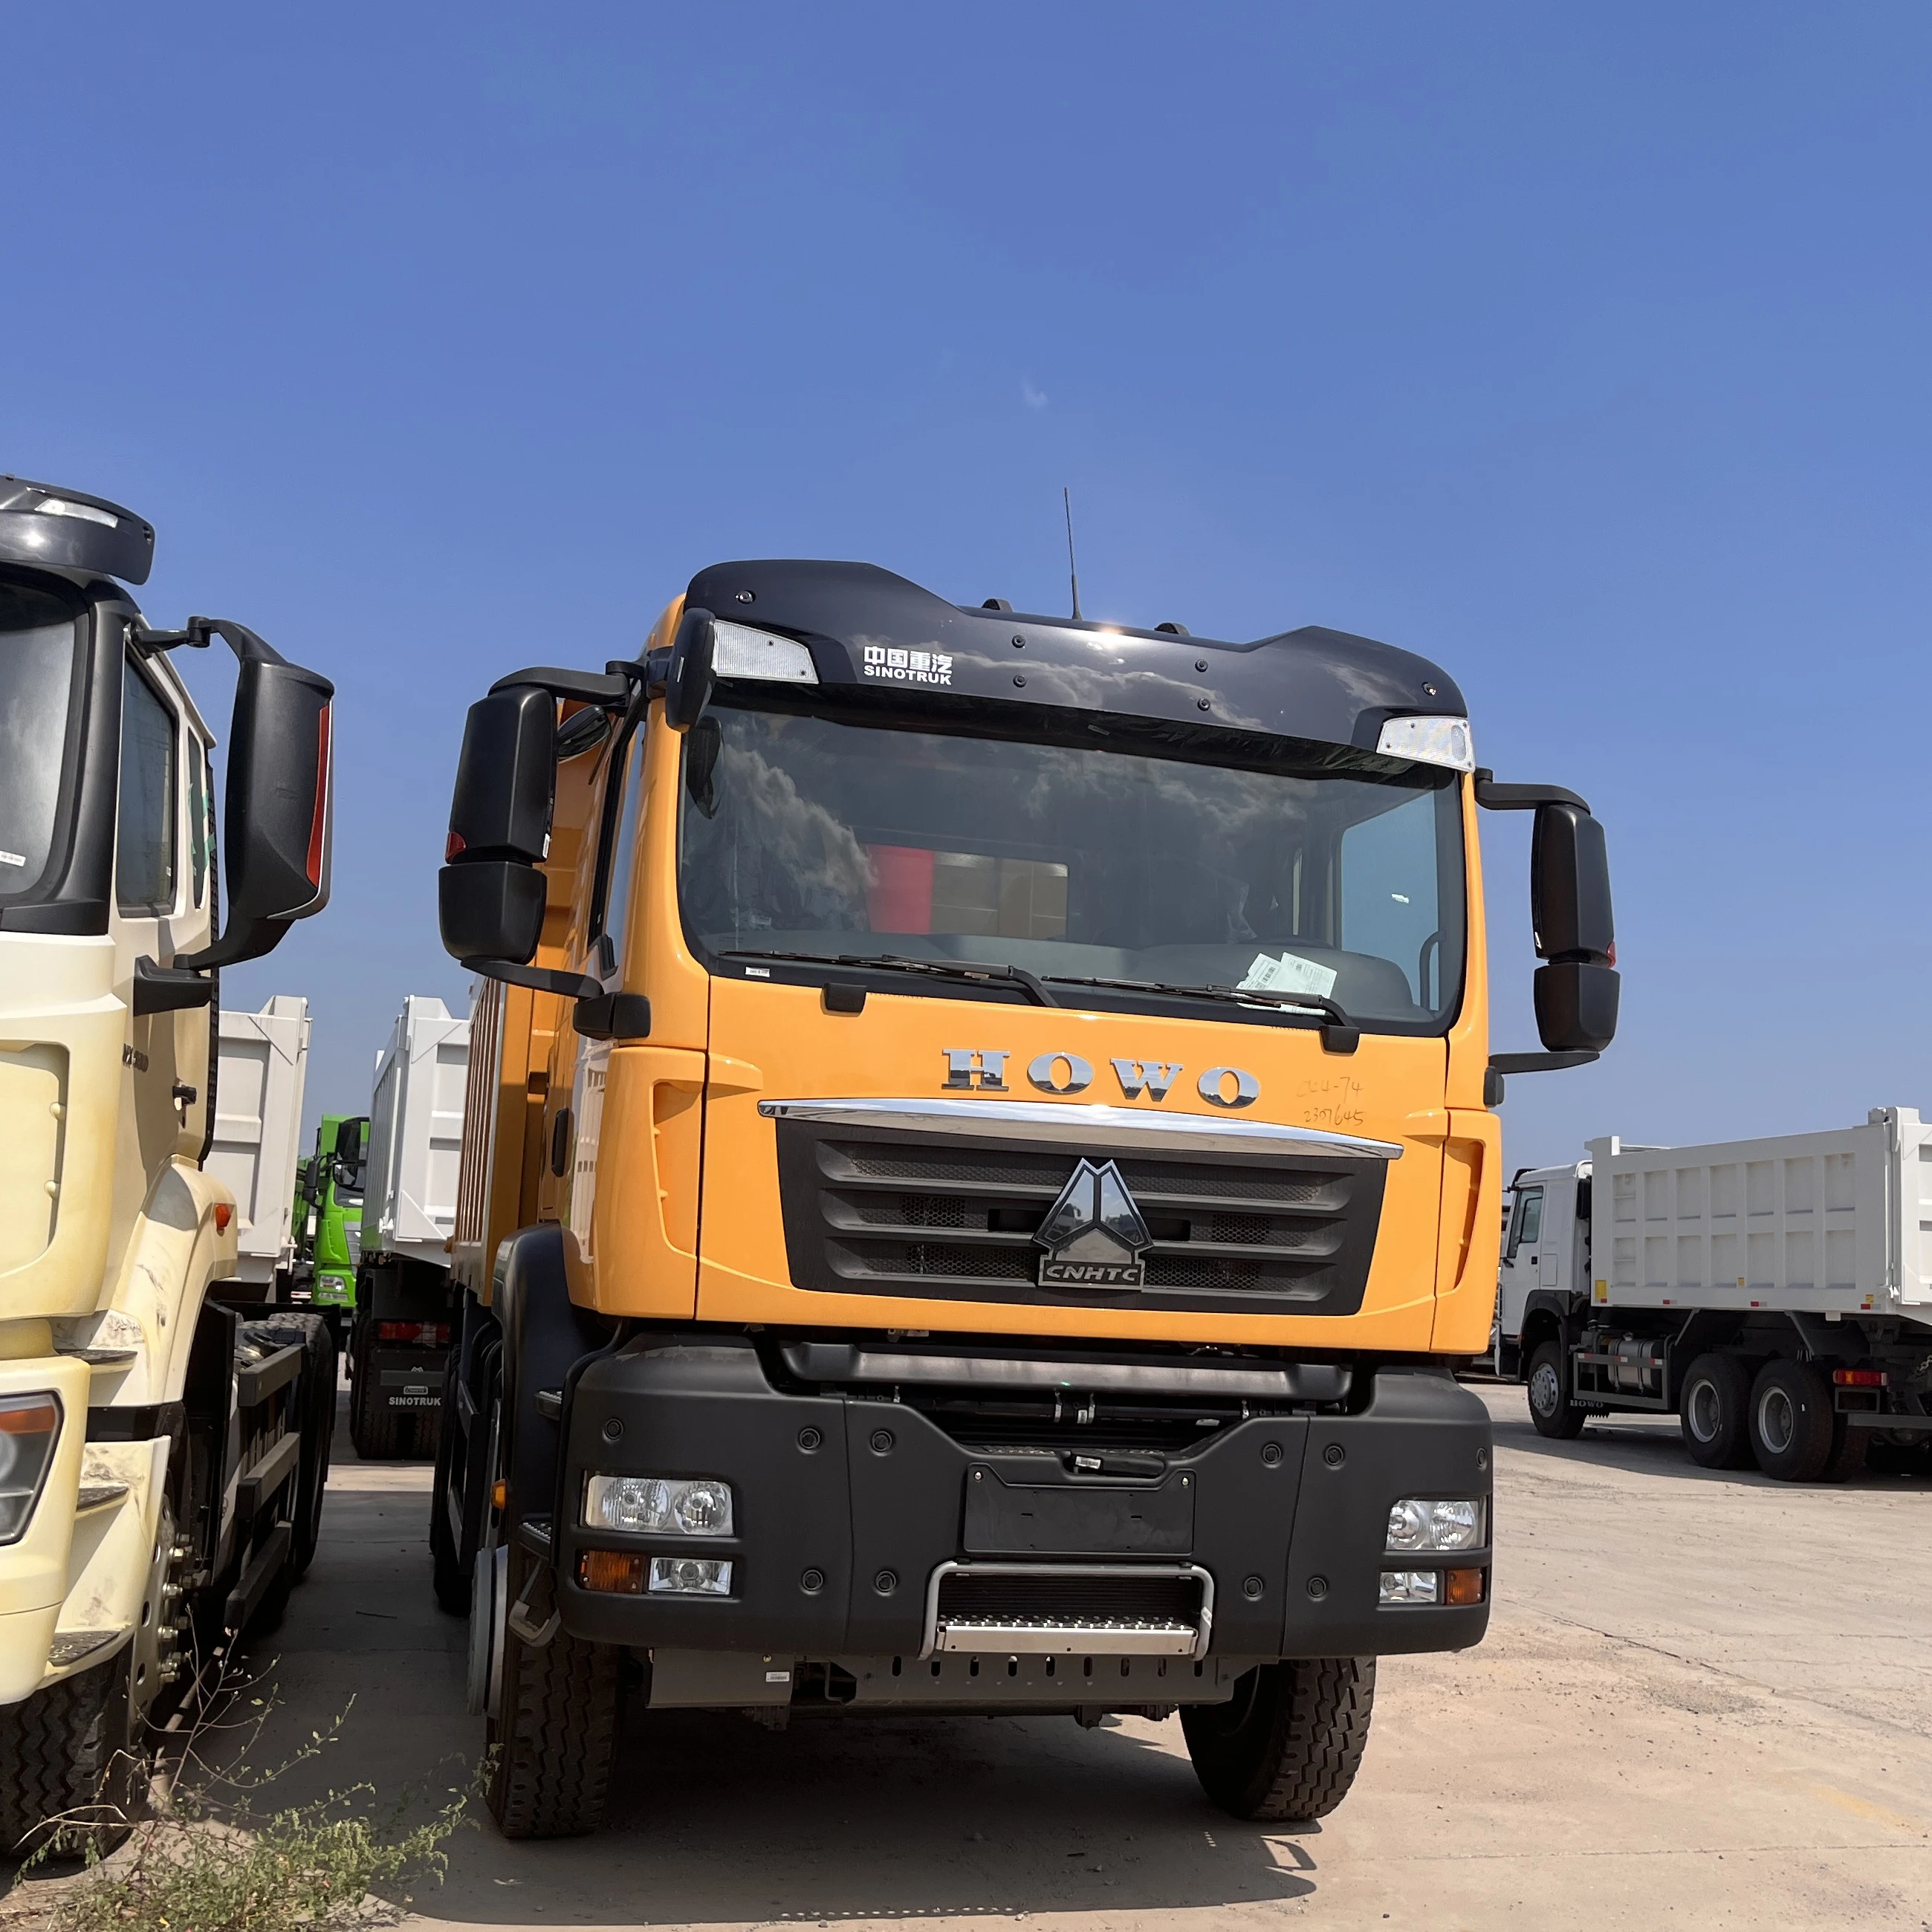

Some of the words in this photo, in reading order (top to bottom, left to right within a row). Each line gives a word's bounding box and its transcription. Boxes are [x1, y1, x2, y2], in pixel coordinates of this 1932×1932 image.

[863, 646, 953, 675] 中国重汽
[863, 665, 952, 685] SINOTRUK
[941, 1048, 1260, 1109] HOWO
[1046, 1265, 1138, 1282] CNHTC
[388, 1396, 442, 1407] SINOTRUK
[1569, 1399, 1604, 1408] HOWO
